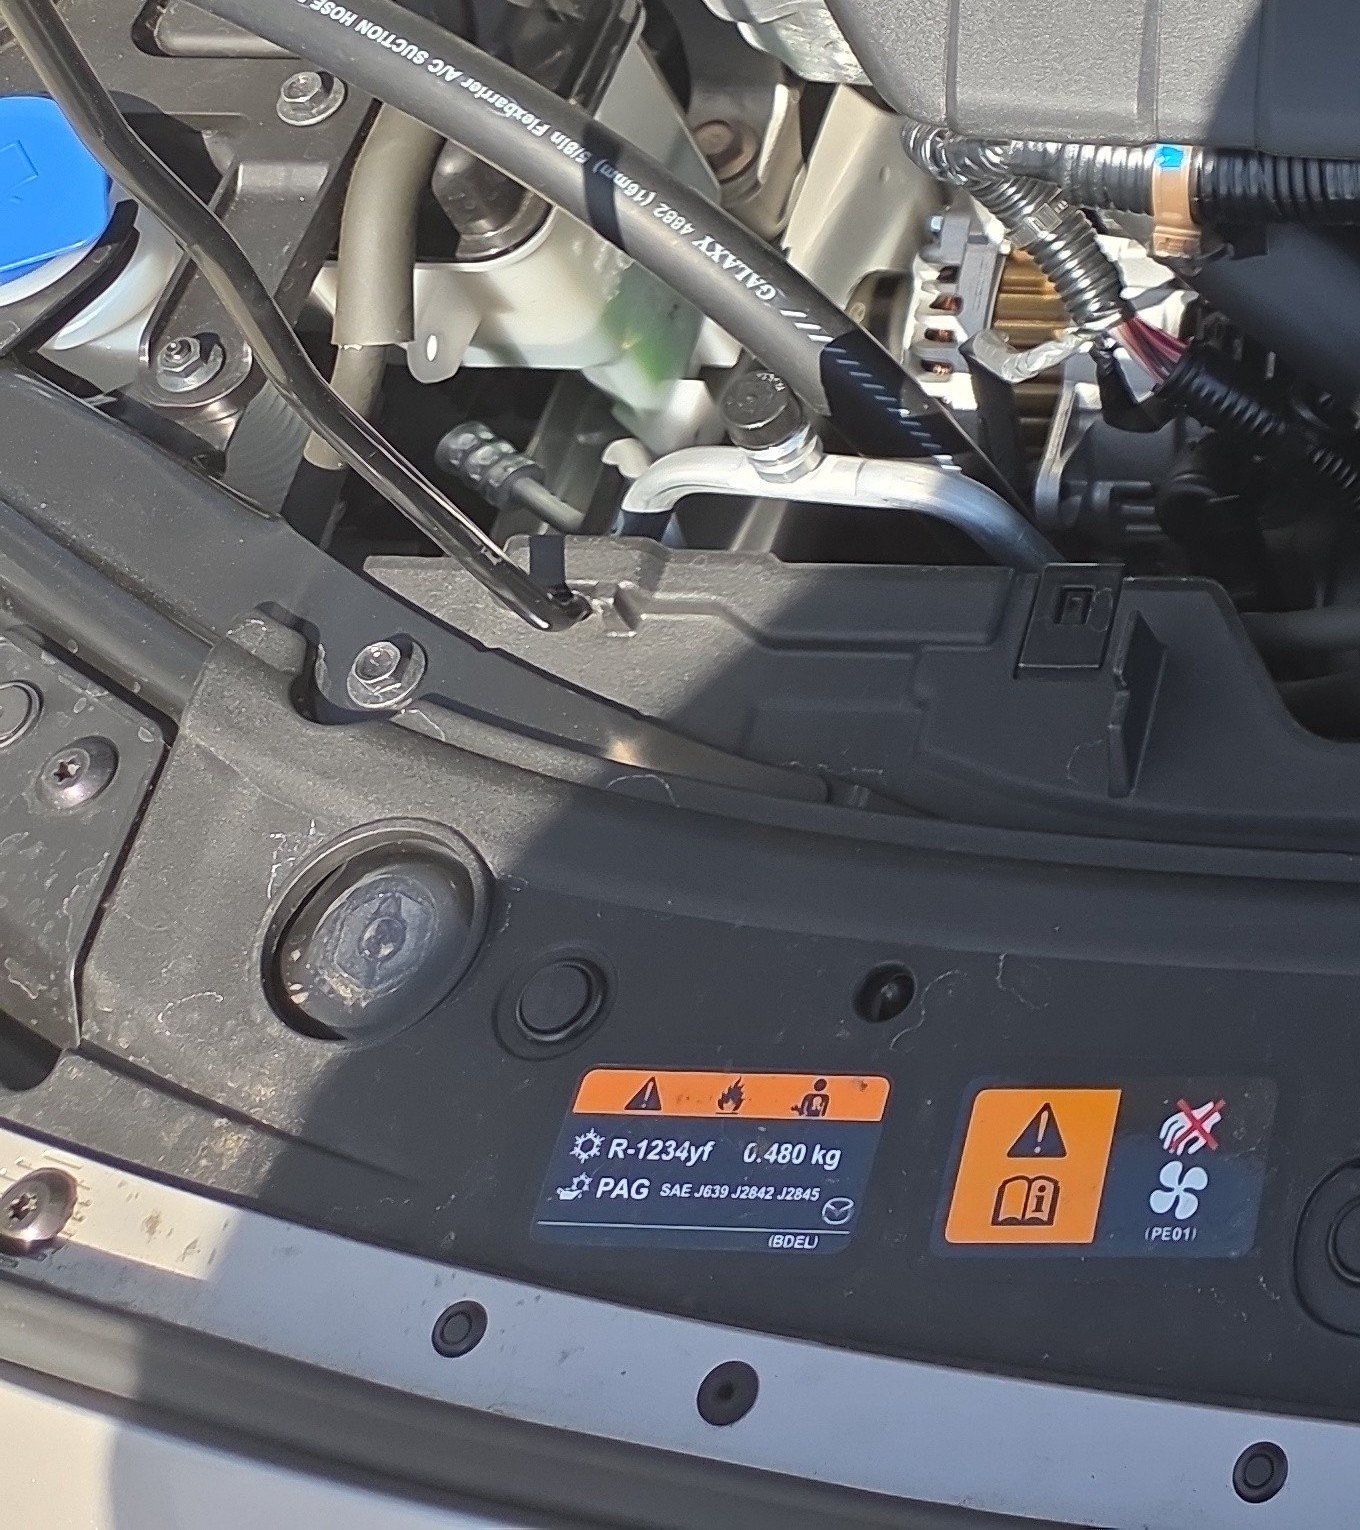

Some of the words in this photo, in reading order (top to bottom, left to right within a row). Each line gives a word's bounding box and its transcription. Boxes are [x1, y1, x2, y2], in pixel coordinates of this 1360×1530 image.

[353, 18, 429, 65] SUCTION
[427, 58, 464, 82] A/C
[460, 77, 551, 137] Flexbarrier
[550, 130, 592, 164] 5/8in
[593, 158, 658, 207] (16mm)
[652, 202, 695, 236] 4882
[691, 234, 777, 300] GALAXY
[607, 1138, 716, 1166] R-1234yf
[742, 1142, 807, 1166] 0.480
[810, 1143, 842, 1171] kg
[595, 1177, 650, 1200] PAG
[659, 1183, 693, 1198] SAE
[693, 1184, 729, 1200] J639
[730, 1185, 774, 1201] J2842
[776, 1186, 821, 1202] J2845
[767, 1234, 819, 1250] (BDEL)
[1144, 1226, 1197, 1242] (PE01)
